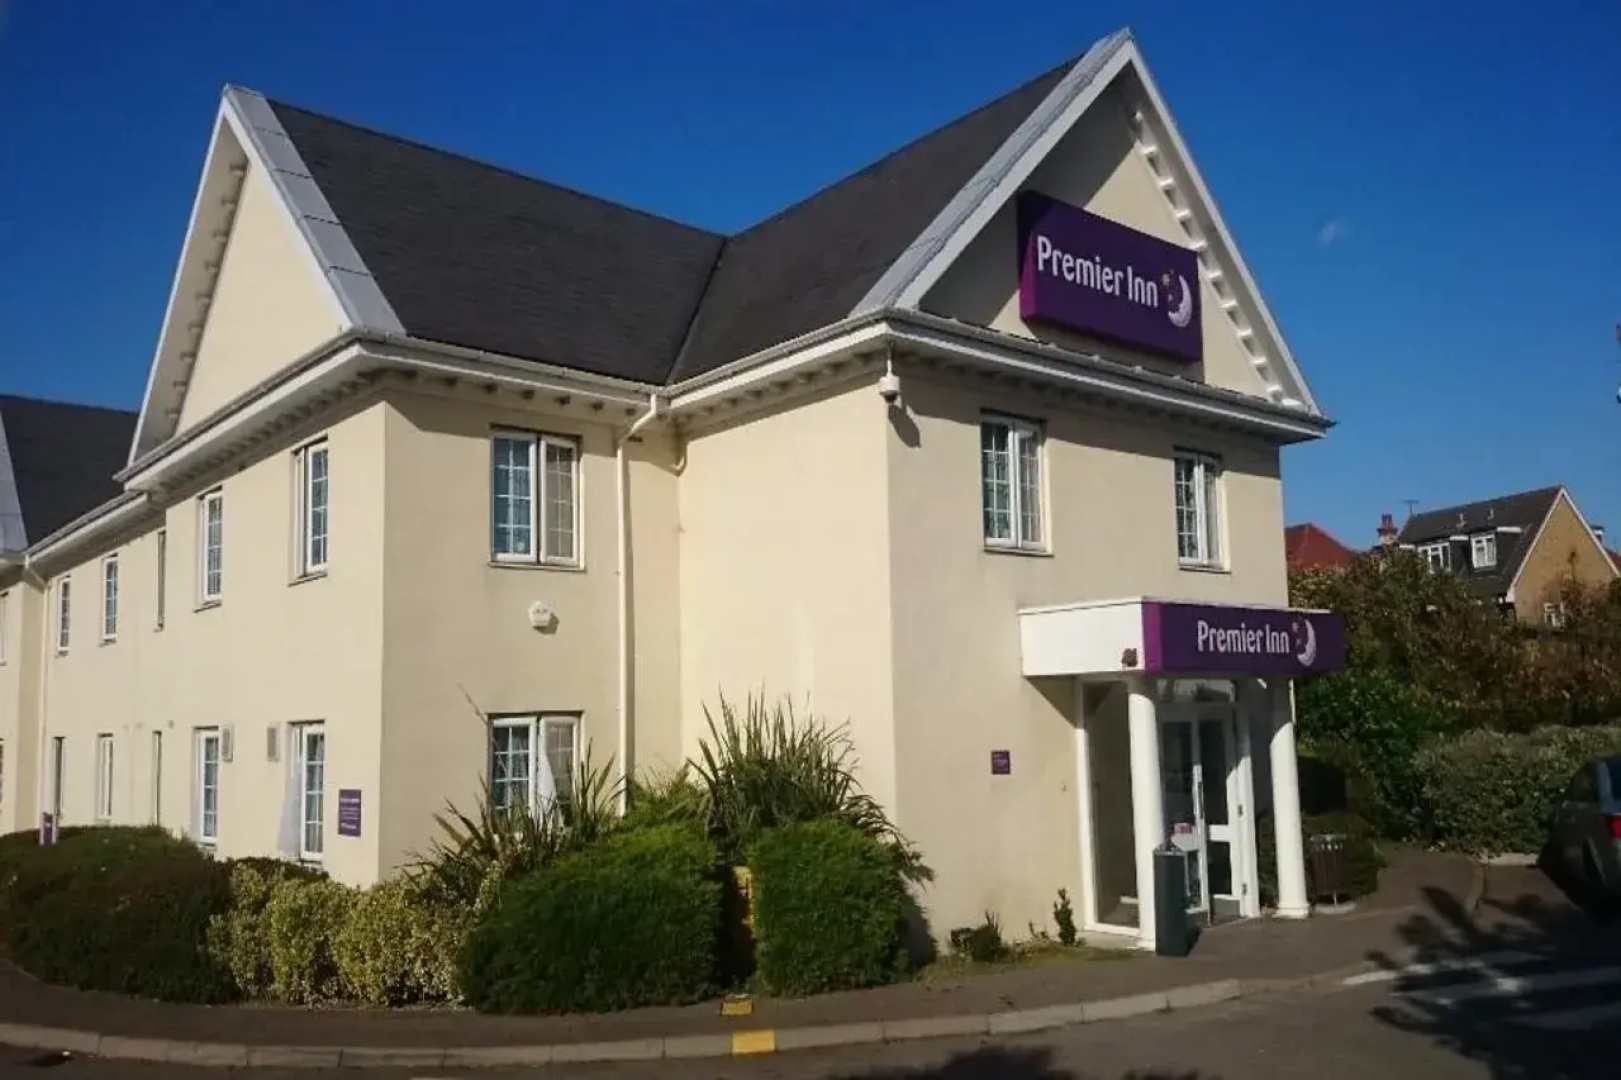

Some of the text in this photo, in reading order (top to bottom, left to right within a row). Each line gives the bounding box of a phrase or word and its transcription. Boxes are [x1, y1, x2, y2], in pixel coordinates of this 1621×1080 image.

[1036, 235, 1159, 308] Premier Inn
[1197, 619, 1290, 654] Premier Inn
